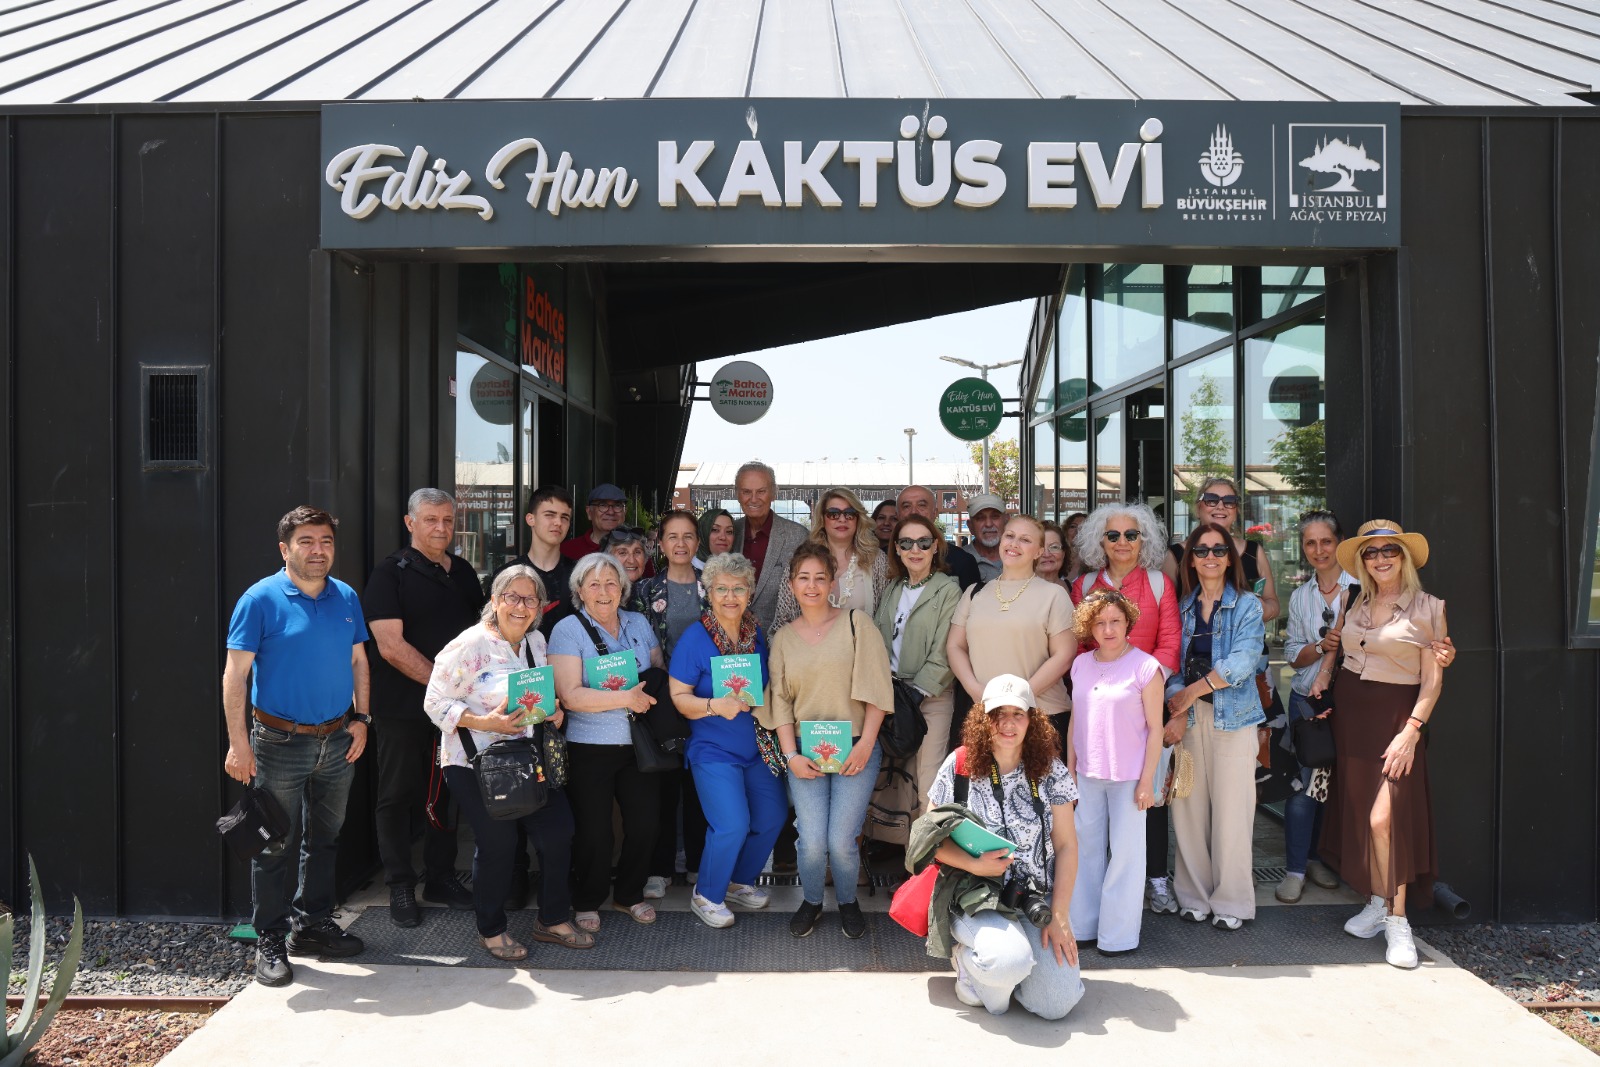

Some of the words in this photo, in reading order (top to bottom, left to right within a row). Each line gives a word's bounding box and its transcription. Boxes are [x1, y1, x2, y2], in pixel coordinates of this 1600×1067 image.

[326, 142, 493, 221] Ediz
[485, 137, 638, 216] Hun
[657, 115, 1007, 208] KAKTÜS
[1027, 117, 1164, 209] EVİ
[1188, 187, 1255, 196] İSTANBUL
[1177, 196, 1267, 211] BÜYÜKŞEHİR
[1302, 192, 1374, 208] İSTANBUL
[1182, 212, 1263, 221] BELEDİYESİ
[1290, 209, 1325, 224] AĞAÇ
[1328, 211, 1342, 221] VE
[1346, 211, 1387, 224] PEYZAJ
[728, 388, 767, 398] Market
[947, 390, 970, 403] Ediz
[971, 389, 994, 401] Hun
[946, 404, 981, 413] KAKTÜS
[982, 402, 996, 412] EVİ
[991, 764, 999, 785] Nikon
